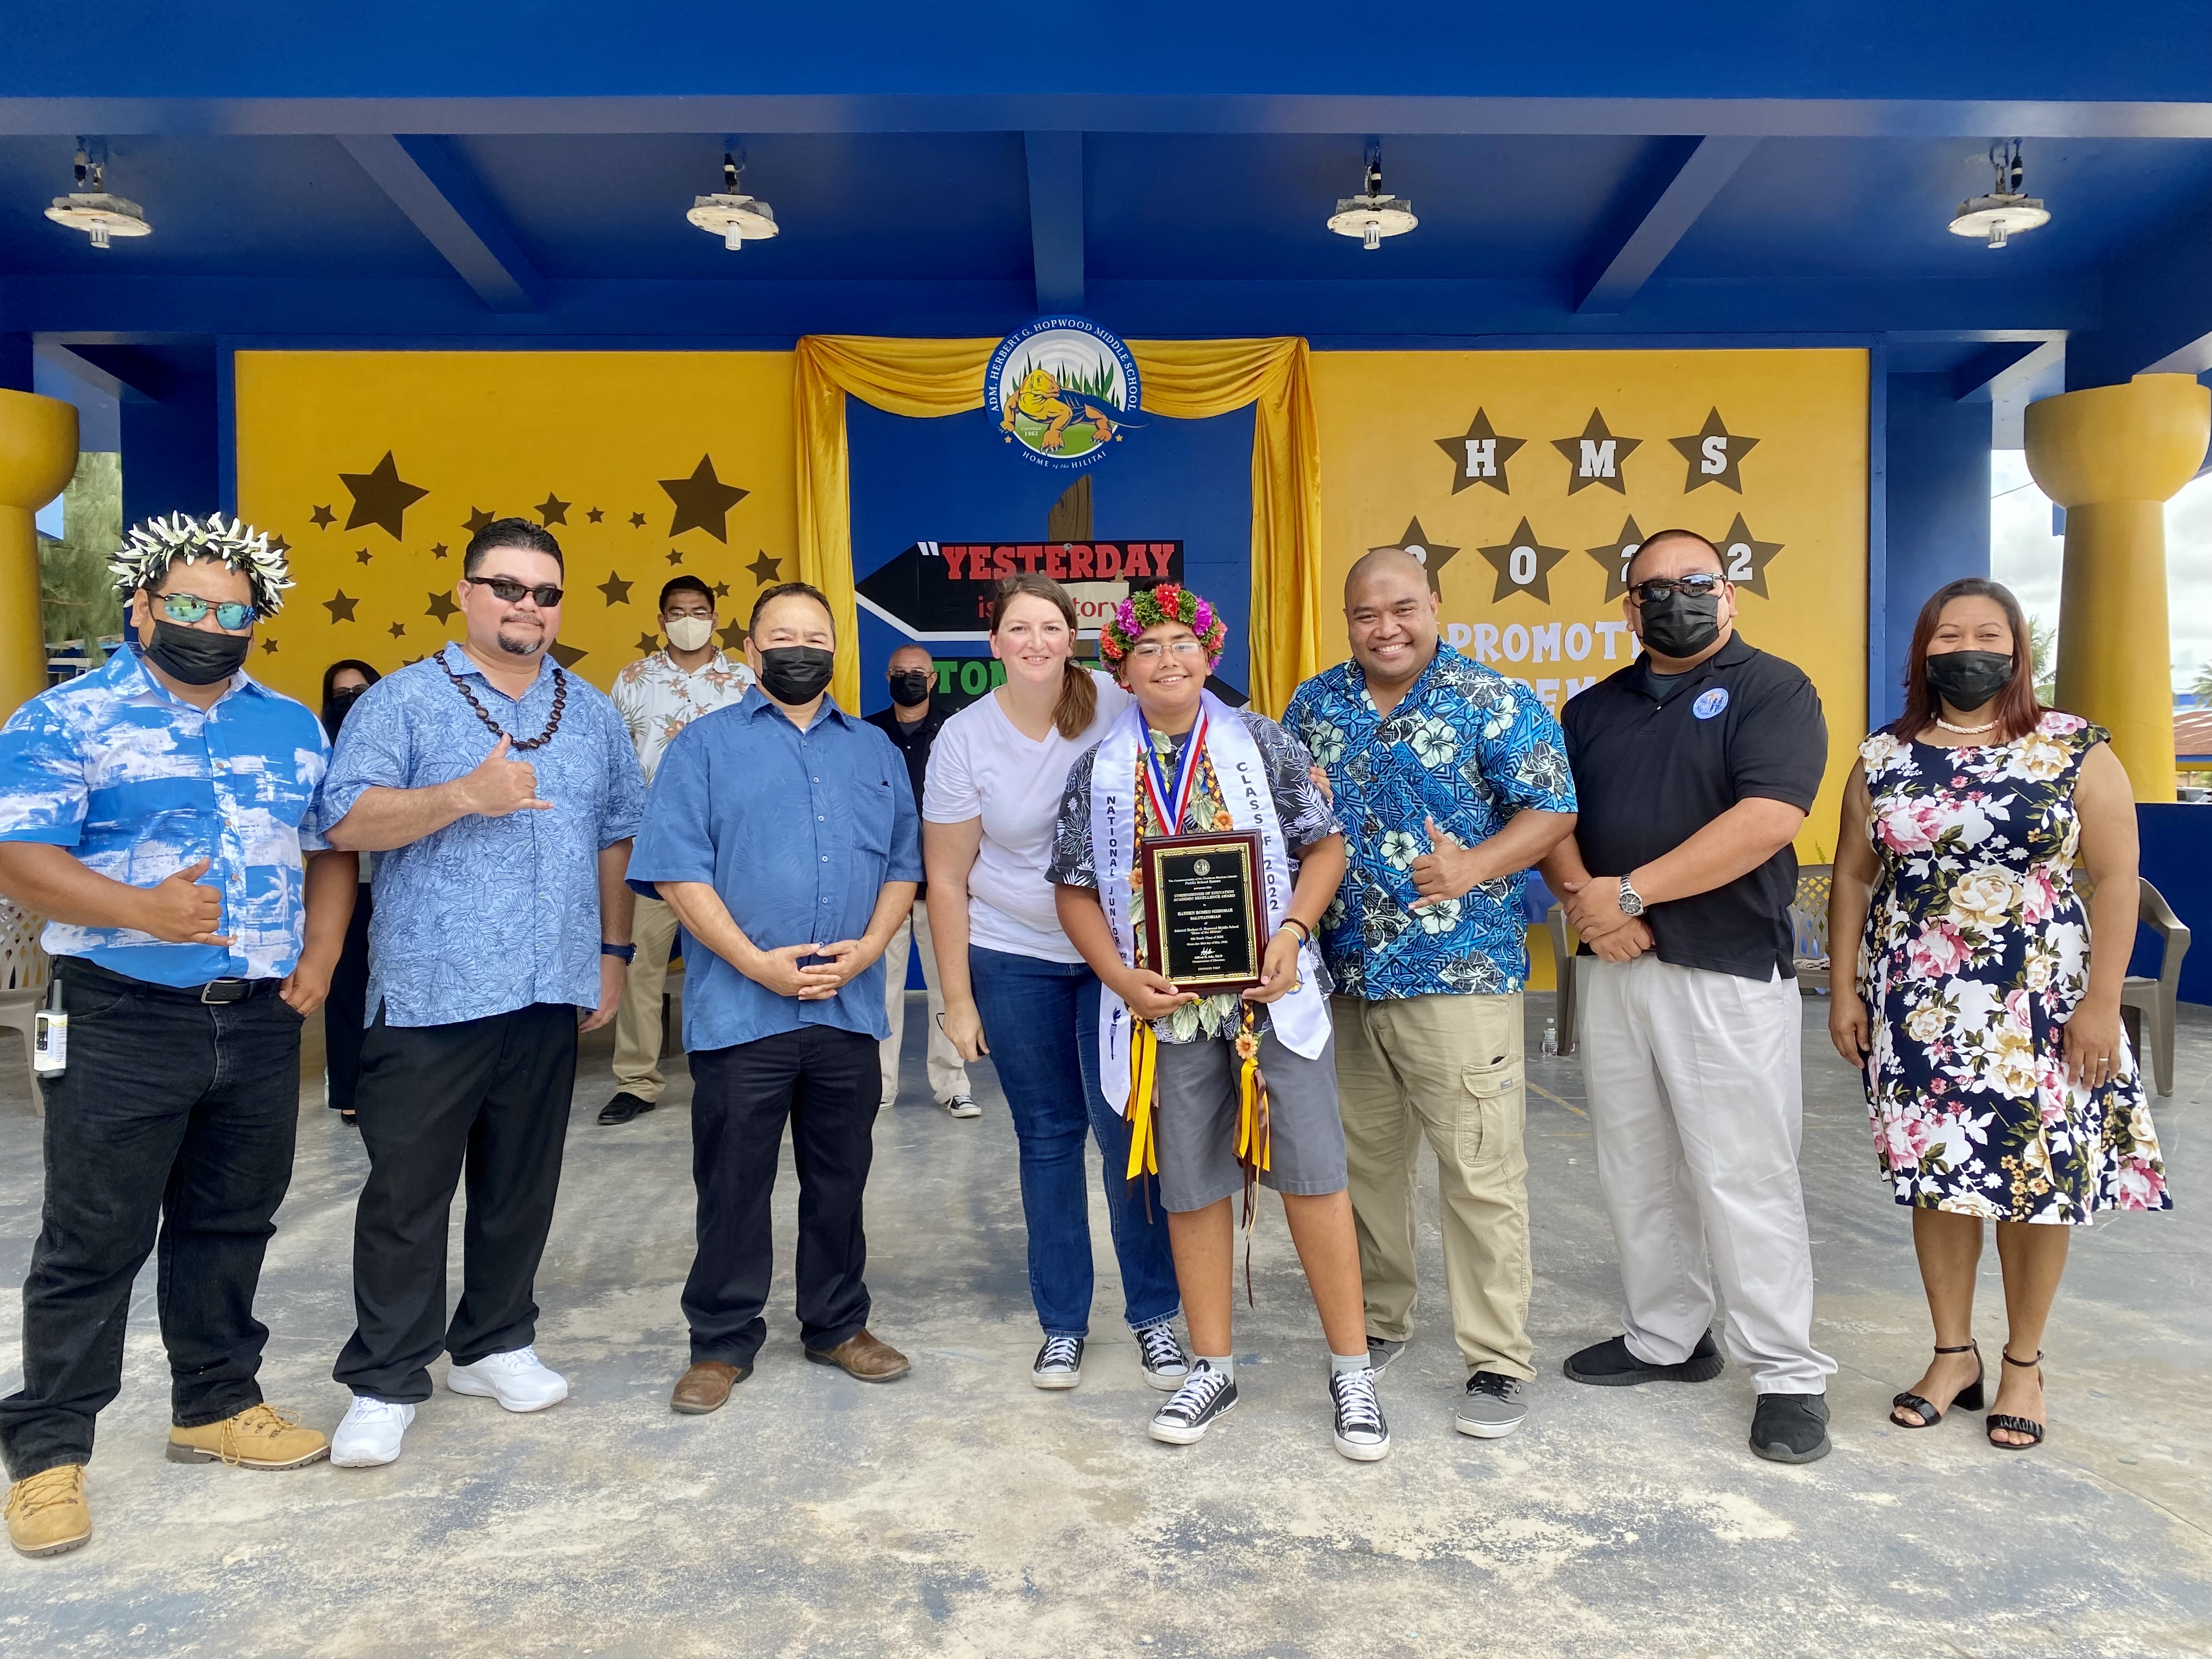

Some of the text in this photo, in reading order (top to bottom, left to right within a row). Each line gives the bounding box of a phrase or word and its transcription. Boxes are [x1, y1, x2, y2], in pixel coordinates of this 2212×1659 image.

[1034, 319, 1092, 331] HOPWOOD
[1094, 327, 1129, 362] MIDDLE
[990, 334, 1021, 380] HERBERT
[989, 383, 1000, 411] ADM.
[1124, 363, 1137, 411] SCHOOL
[1022, 450, 1049, 467] HOME
[1071, 450, 1107, 469] HILITAI
[1235, 761, 1279, 911] CLASS F 2022
[1107, 796, 1121, 945] NATIONAL JUNIOR
